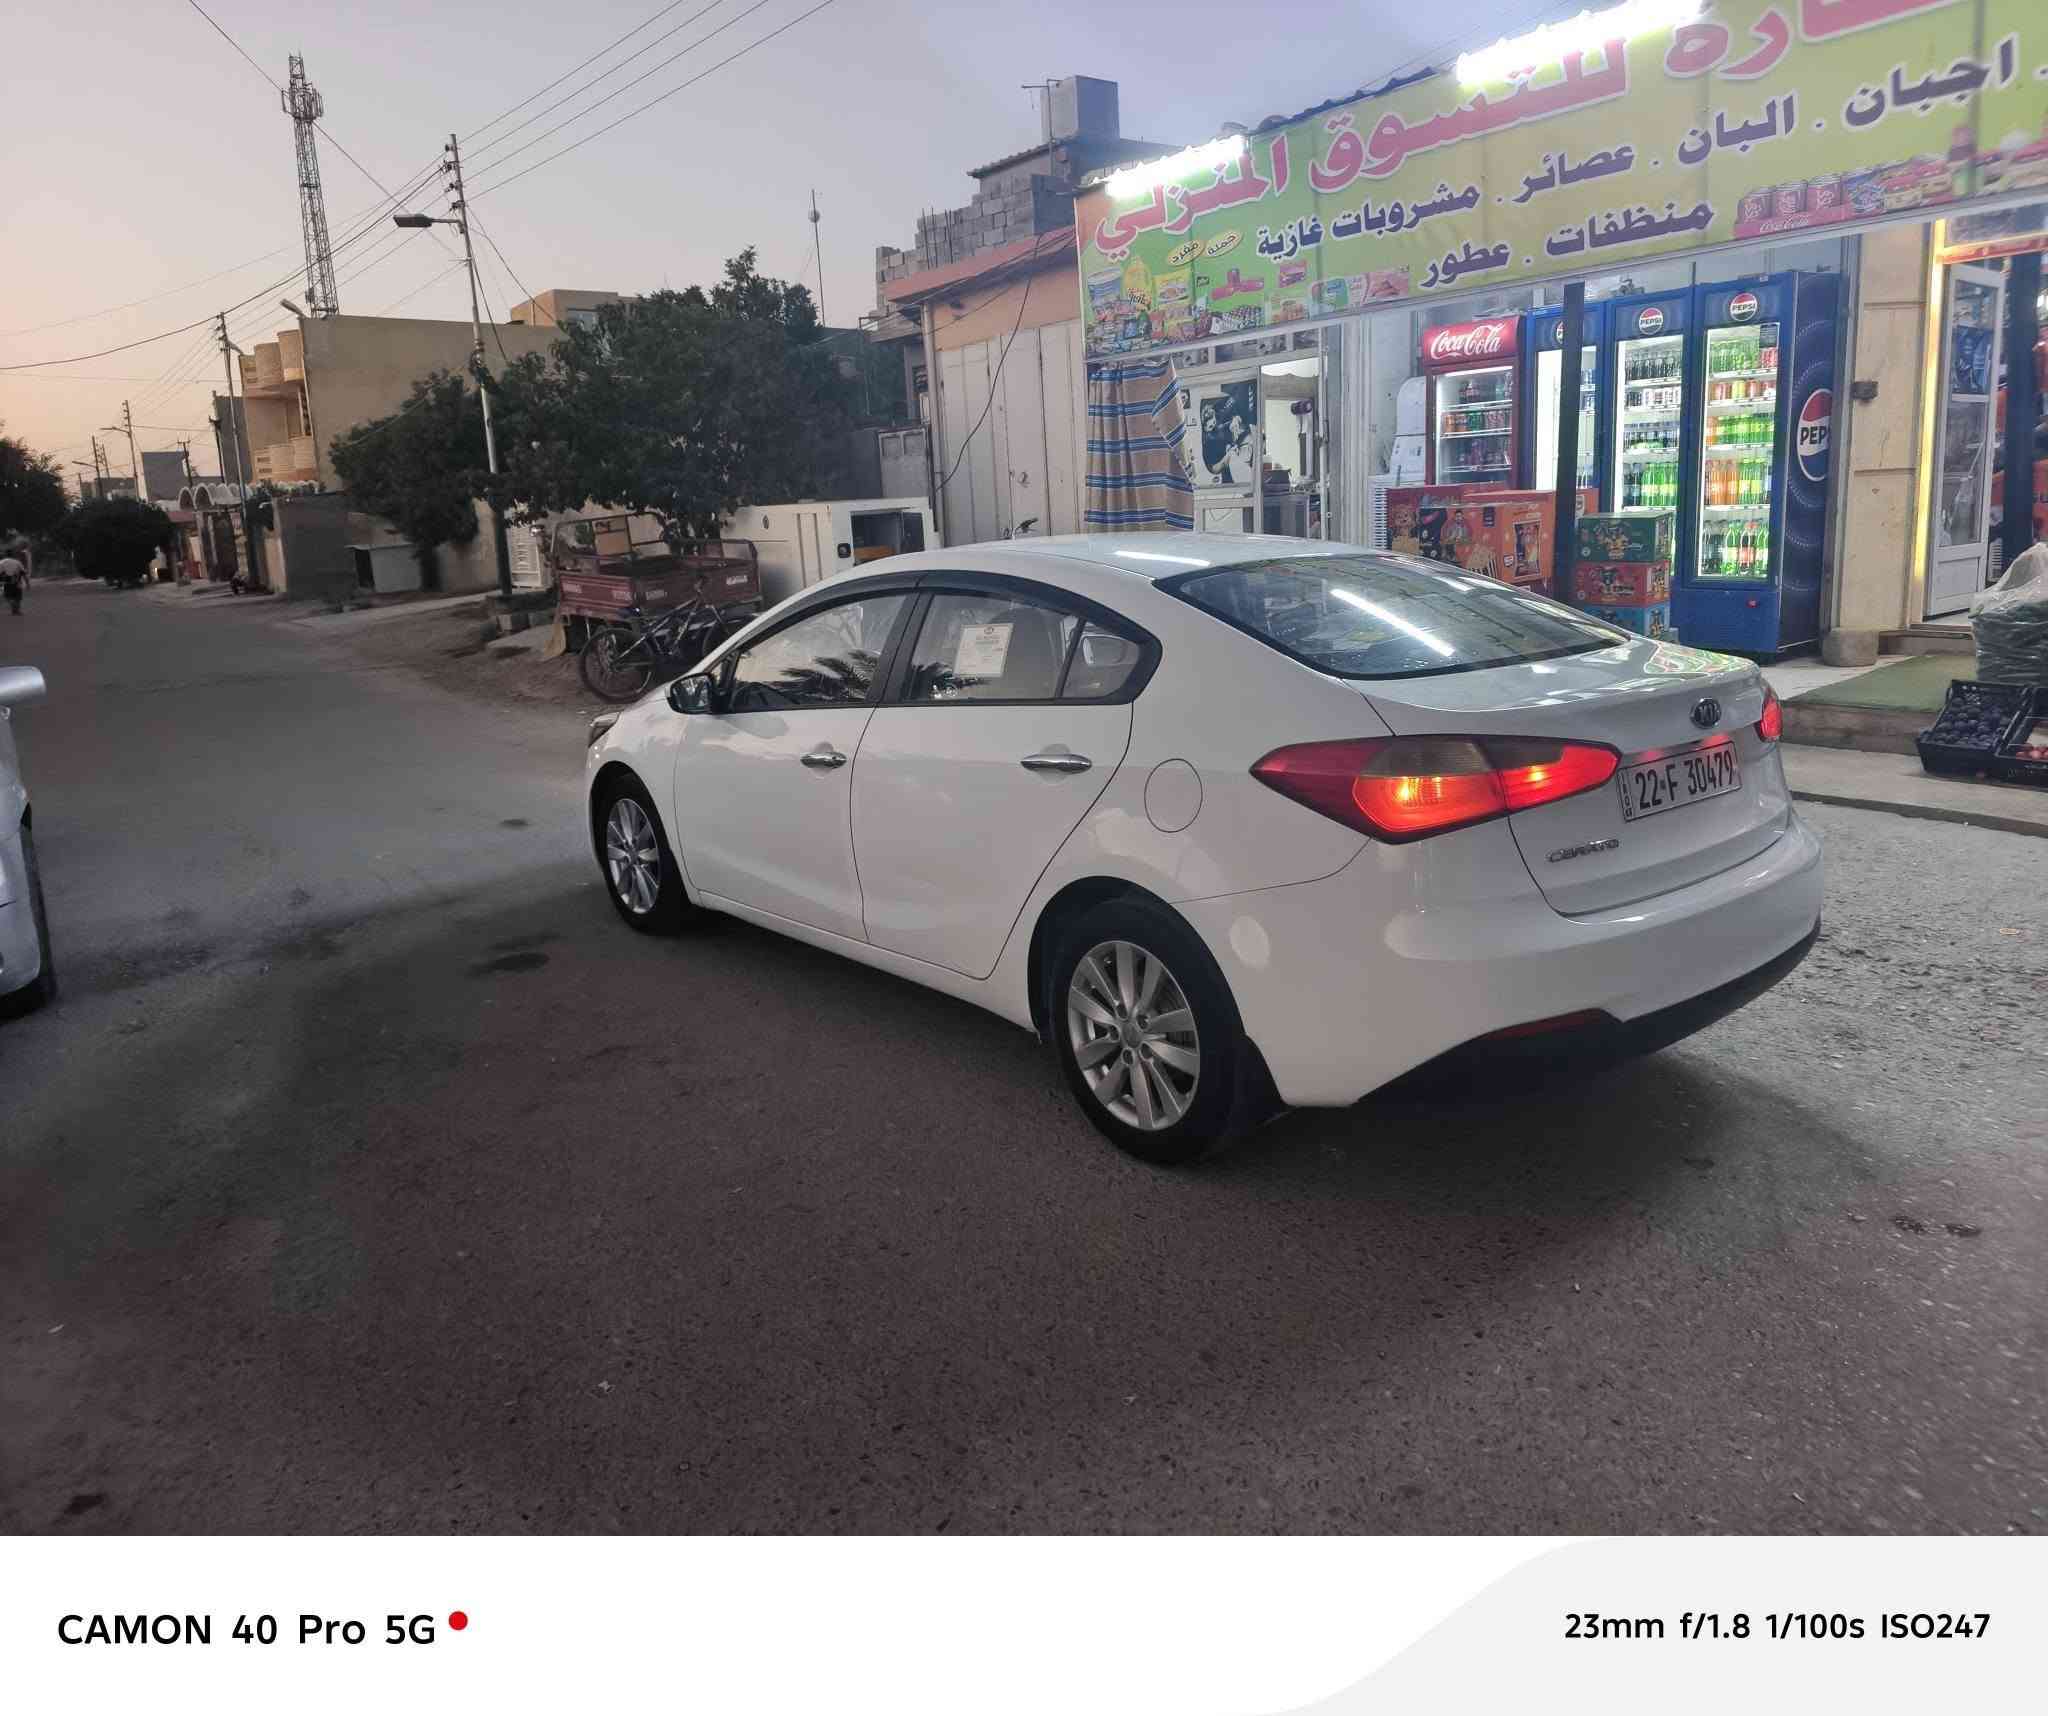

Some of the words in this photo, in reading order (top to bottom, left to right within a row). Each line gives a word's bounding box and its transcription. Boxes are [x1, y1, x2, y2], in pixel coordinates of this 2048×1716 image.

[1845, 38, 2016, 127] اجبان
[1677, 95, 1796, 165] البان
[1513, 145, 1635, 203] عصائر
[1331, 183, 1481, 238] مشروبات
[1546, 201, 1714, 257] منظفات
[1257, 216, 1324, 261] غازية
[1420, 241, 1510, 288] عطور
[1639, 318, 1663, 328] PEPSI
[1731, 302, 1756, 313] PEPSI
[1684, 750, 1735, 796] 30479
